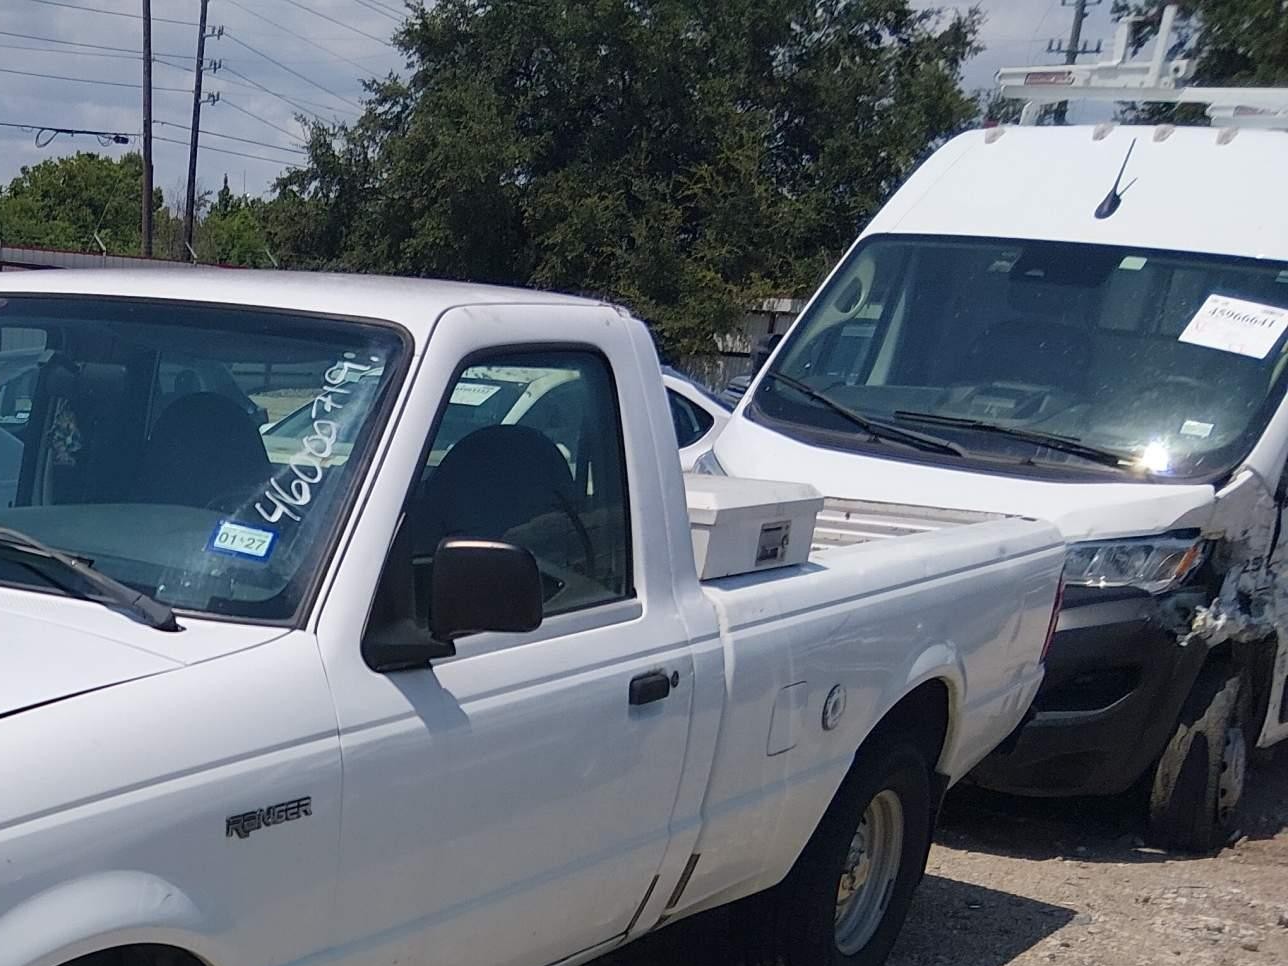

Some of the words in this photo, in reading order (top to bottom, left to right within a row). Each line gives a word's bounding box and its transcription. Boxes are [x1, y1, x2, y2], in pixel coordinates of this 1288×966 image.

[218, 531, 237, 545] 01
[244, 537, 266, 551] 27
[225, 796, 312, 839] RANGER
